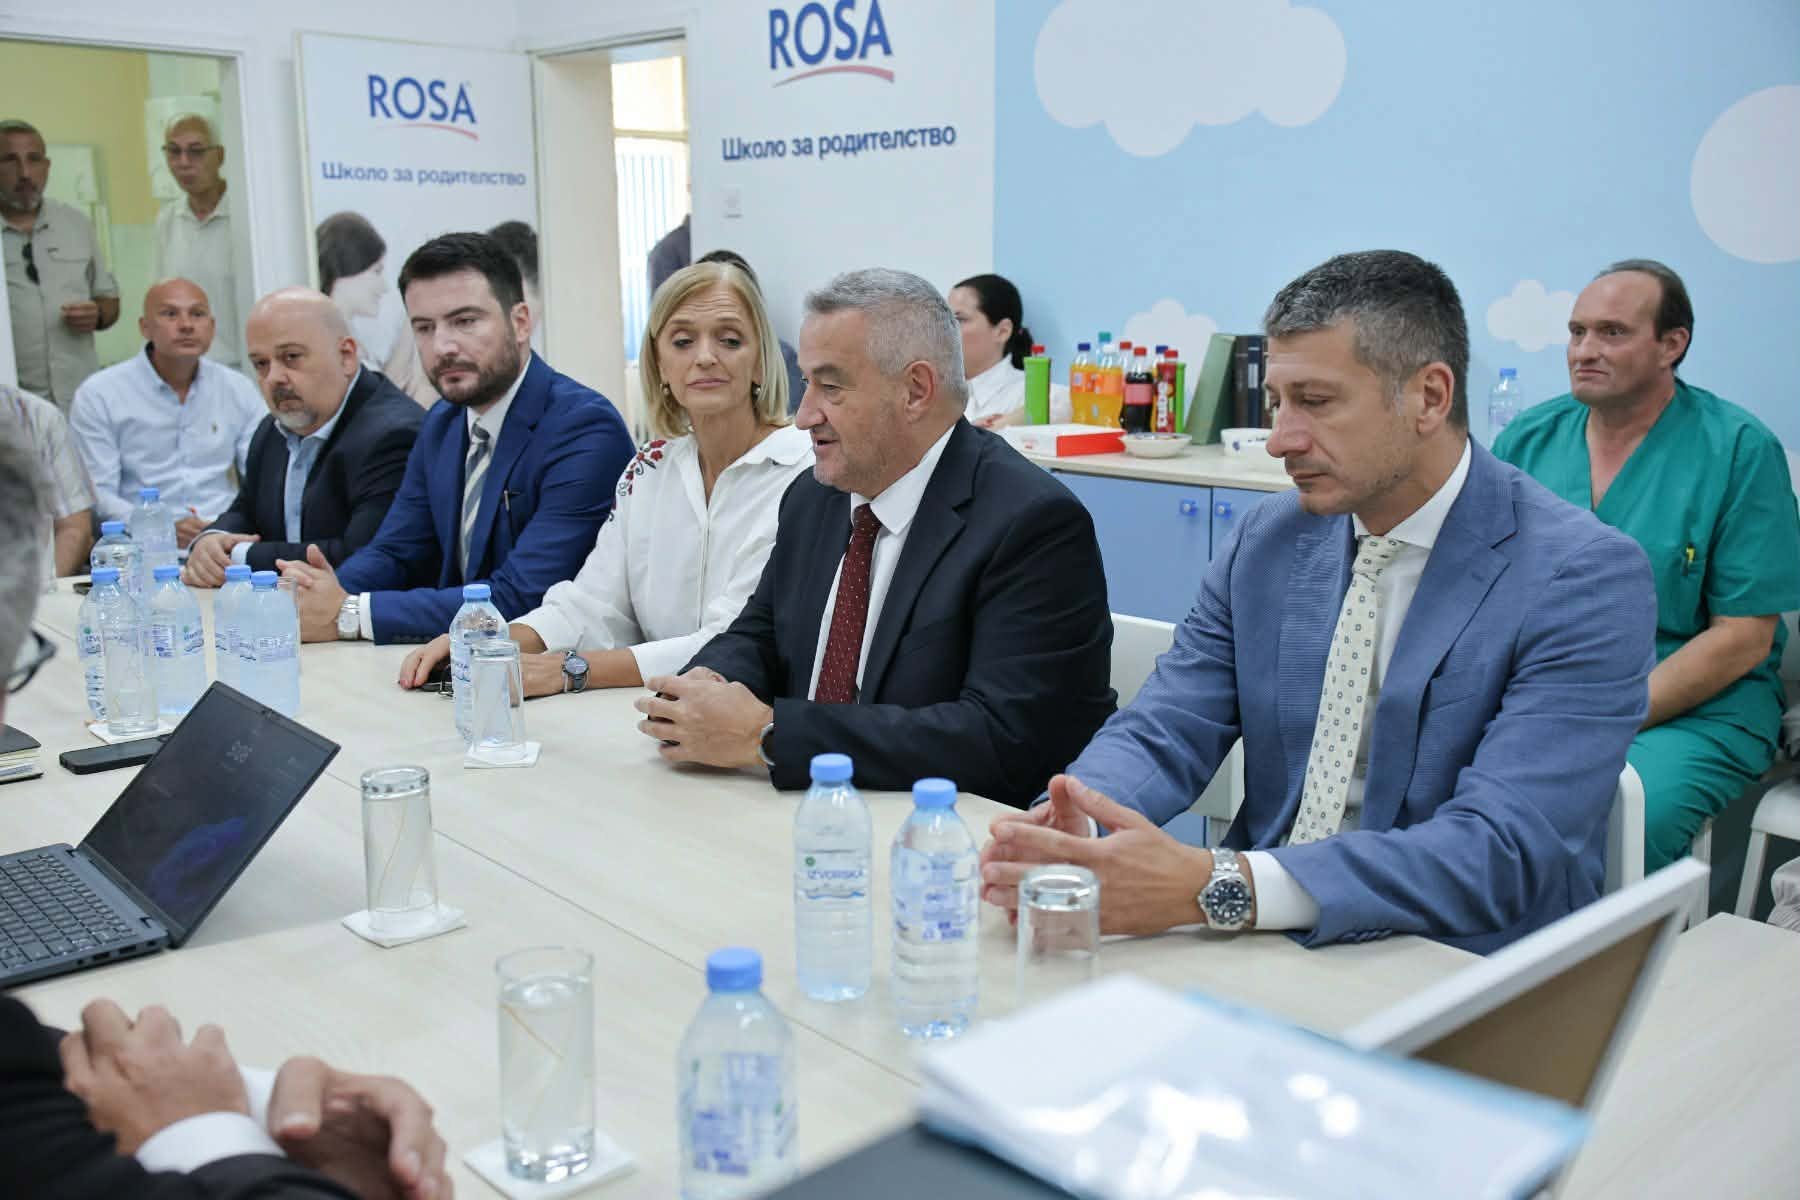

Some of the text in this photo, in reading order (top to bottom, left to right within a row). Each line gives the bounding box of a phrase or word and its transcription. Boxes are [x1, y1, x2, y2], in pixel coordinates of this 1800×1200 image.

[769, 0, 893, 70] ROSA
[368, 74, 477, 124] ROSA
[722, 125, 956, 161] Школо за родителство
[321, 161, 527, 186] Школо за родителство
